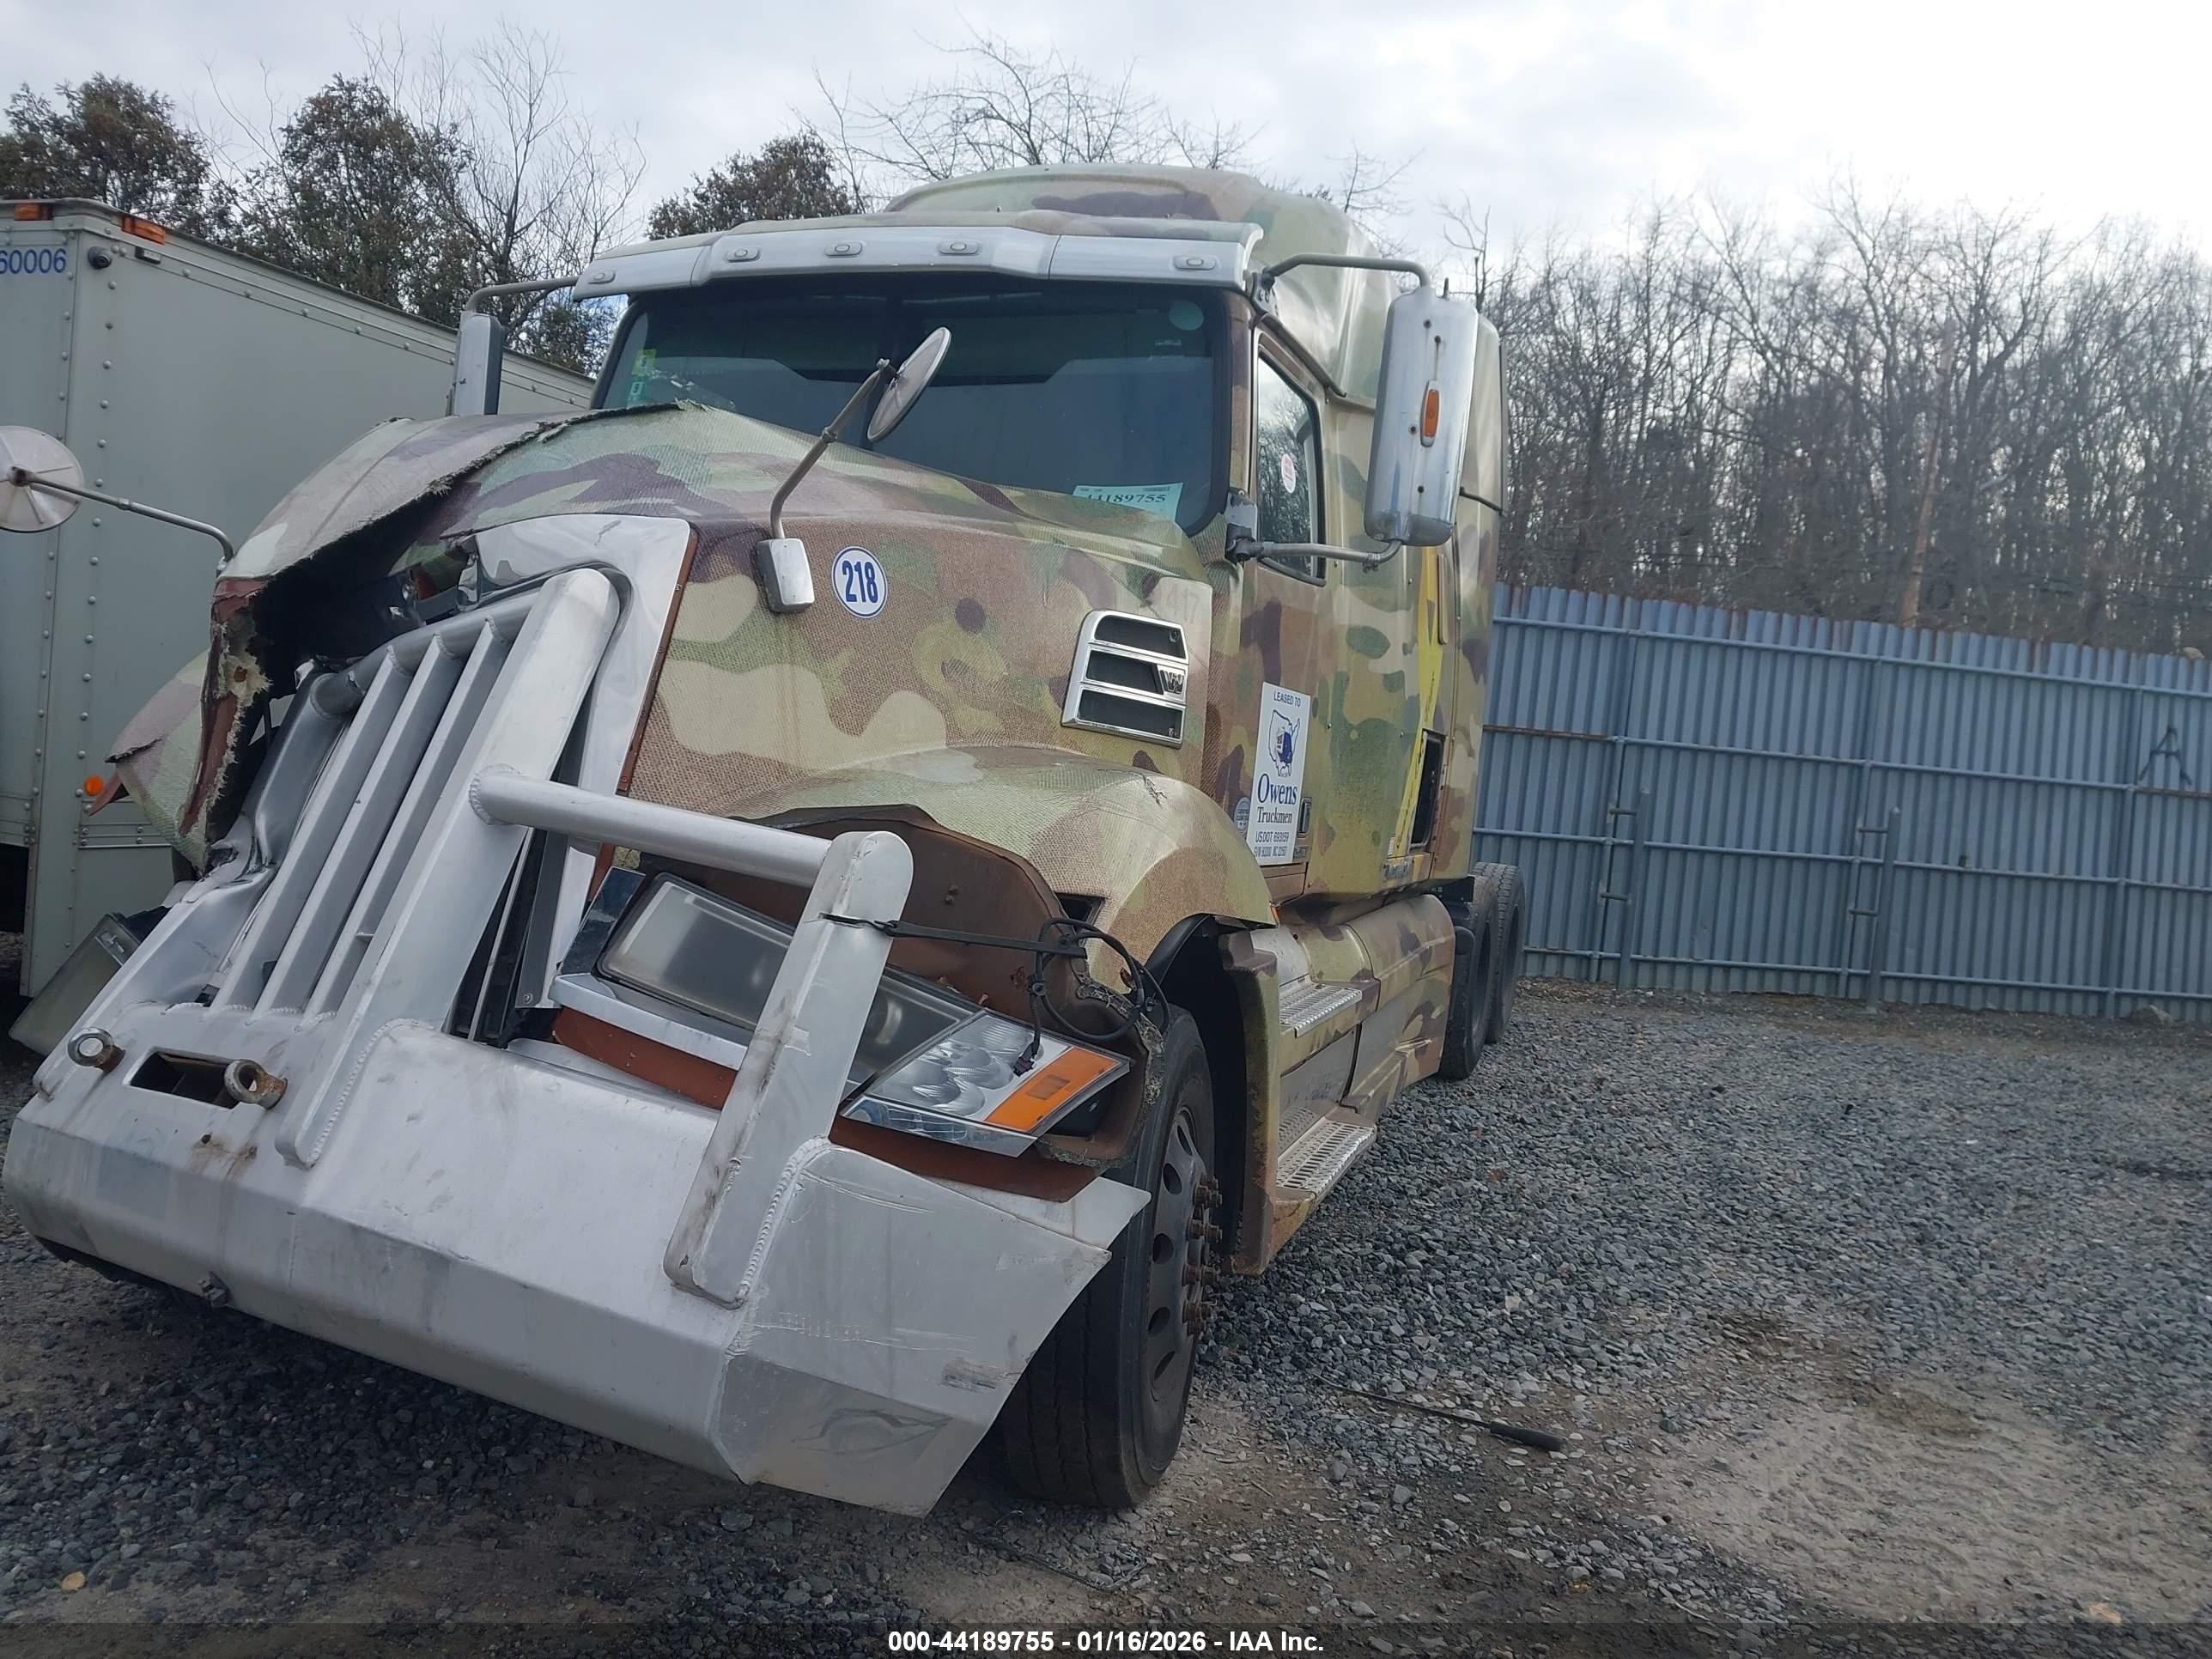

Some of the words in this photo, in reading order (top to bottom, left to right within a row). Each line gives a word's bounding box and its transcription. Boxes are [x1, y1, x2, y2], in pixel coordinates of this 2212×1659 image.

[842, 560, 878, 603] 218
[1273, 690, 1294, 705] LEASED
[1295, 696, 1301, 707] TO
[1258, 773, 1297, 805] Owens
[1257, 806, 1292, 823] Truckmen
